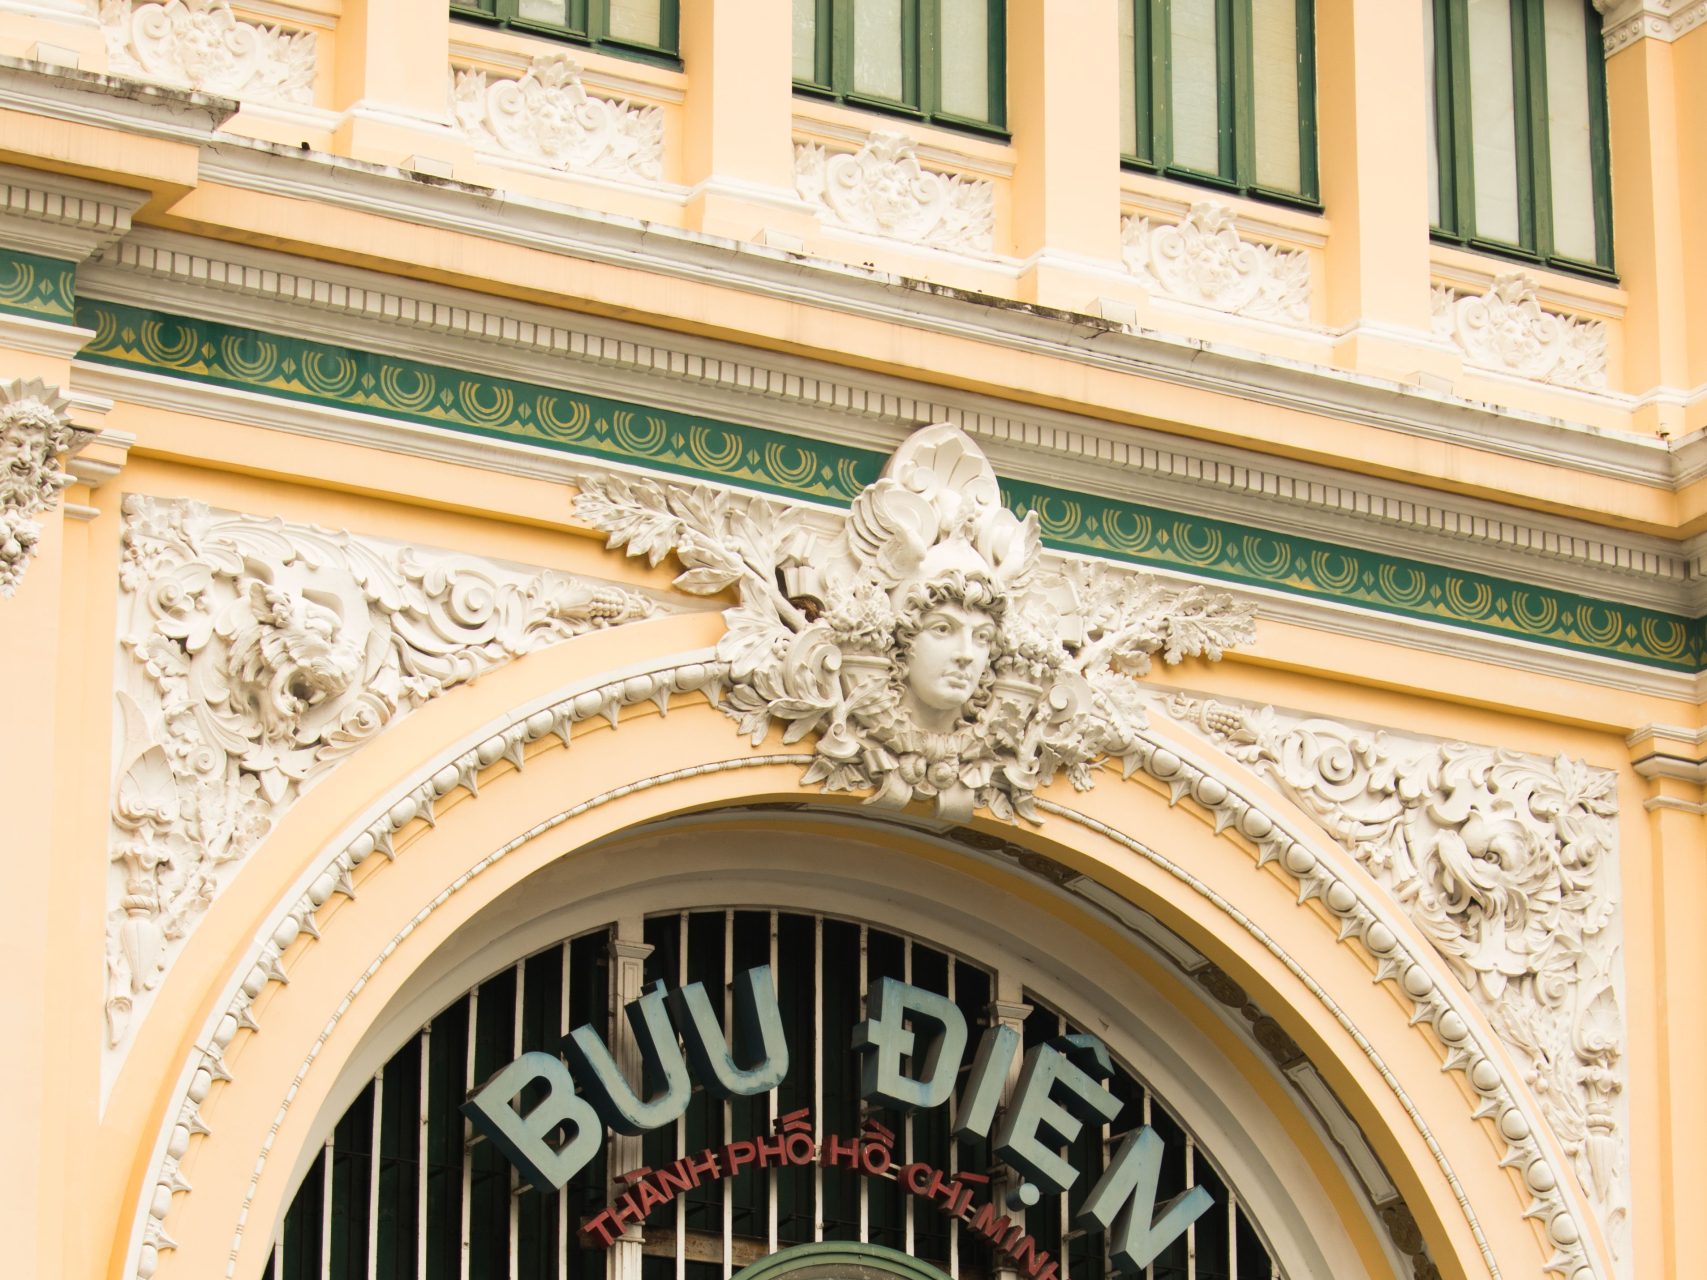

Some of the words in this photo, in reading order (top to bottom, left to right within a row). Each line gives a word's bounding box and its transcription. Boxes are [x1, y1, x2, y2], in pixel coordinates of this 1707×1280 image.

[459, 964, 790, 1192] BƯU
[853, 976, 1215, 1273] ĐIỆN
[577, 1148, 721, 1248] THÀNH
[722, 1107, 816, 1177] PHỐ
[821, 1119, 895, 1174] HỒ
[898, 1162, 990, 1219] CHÍ
